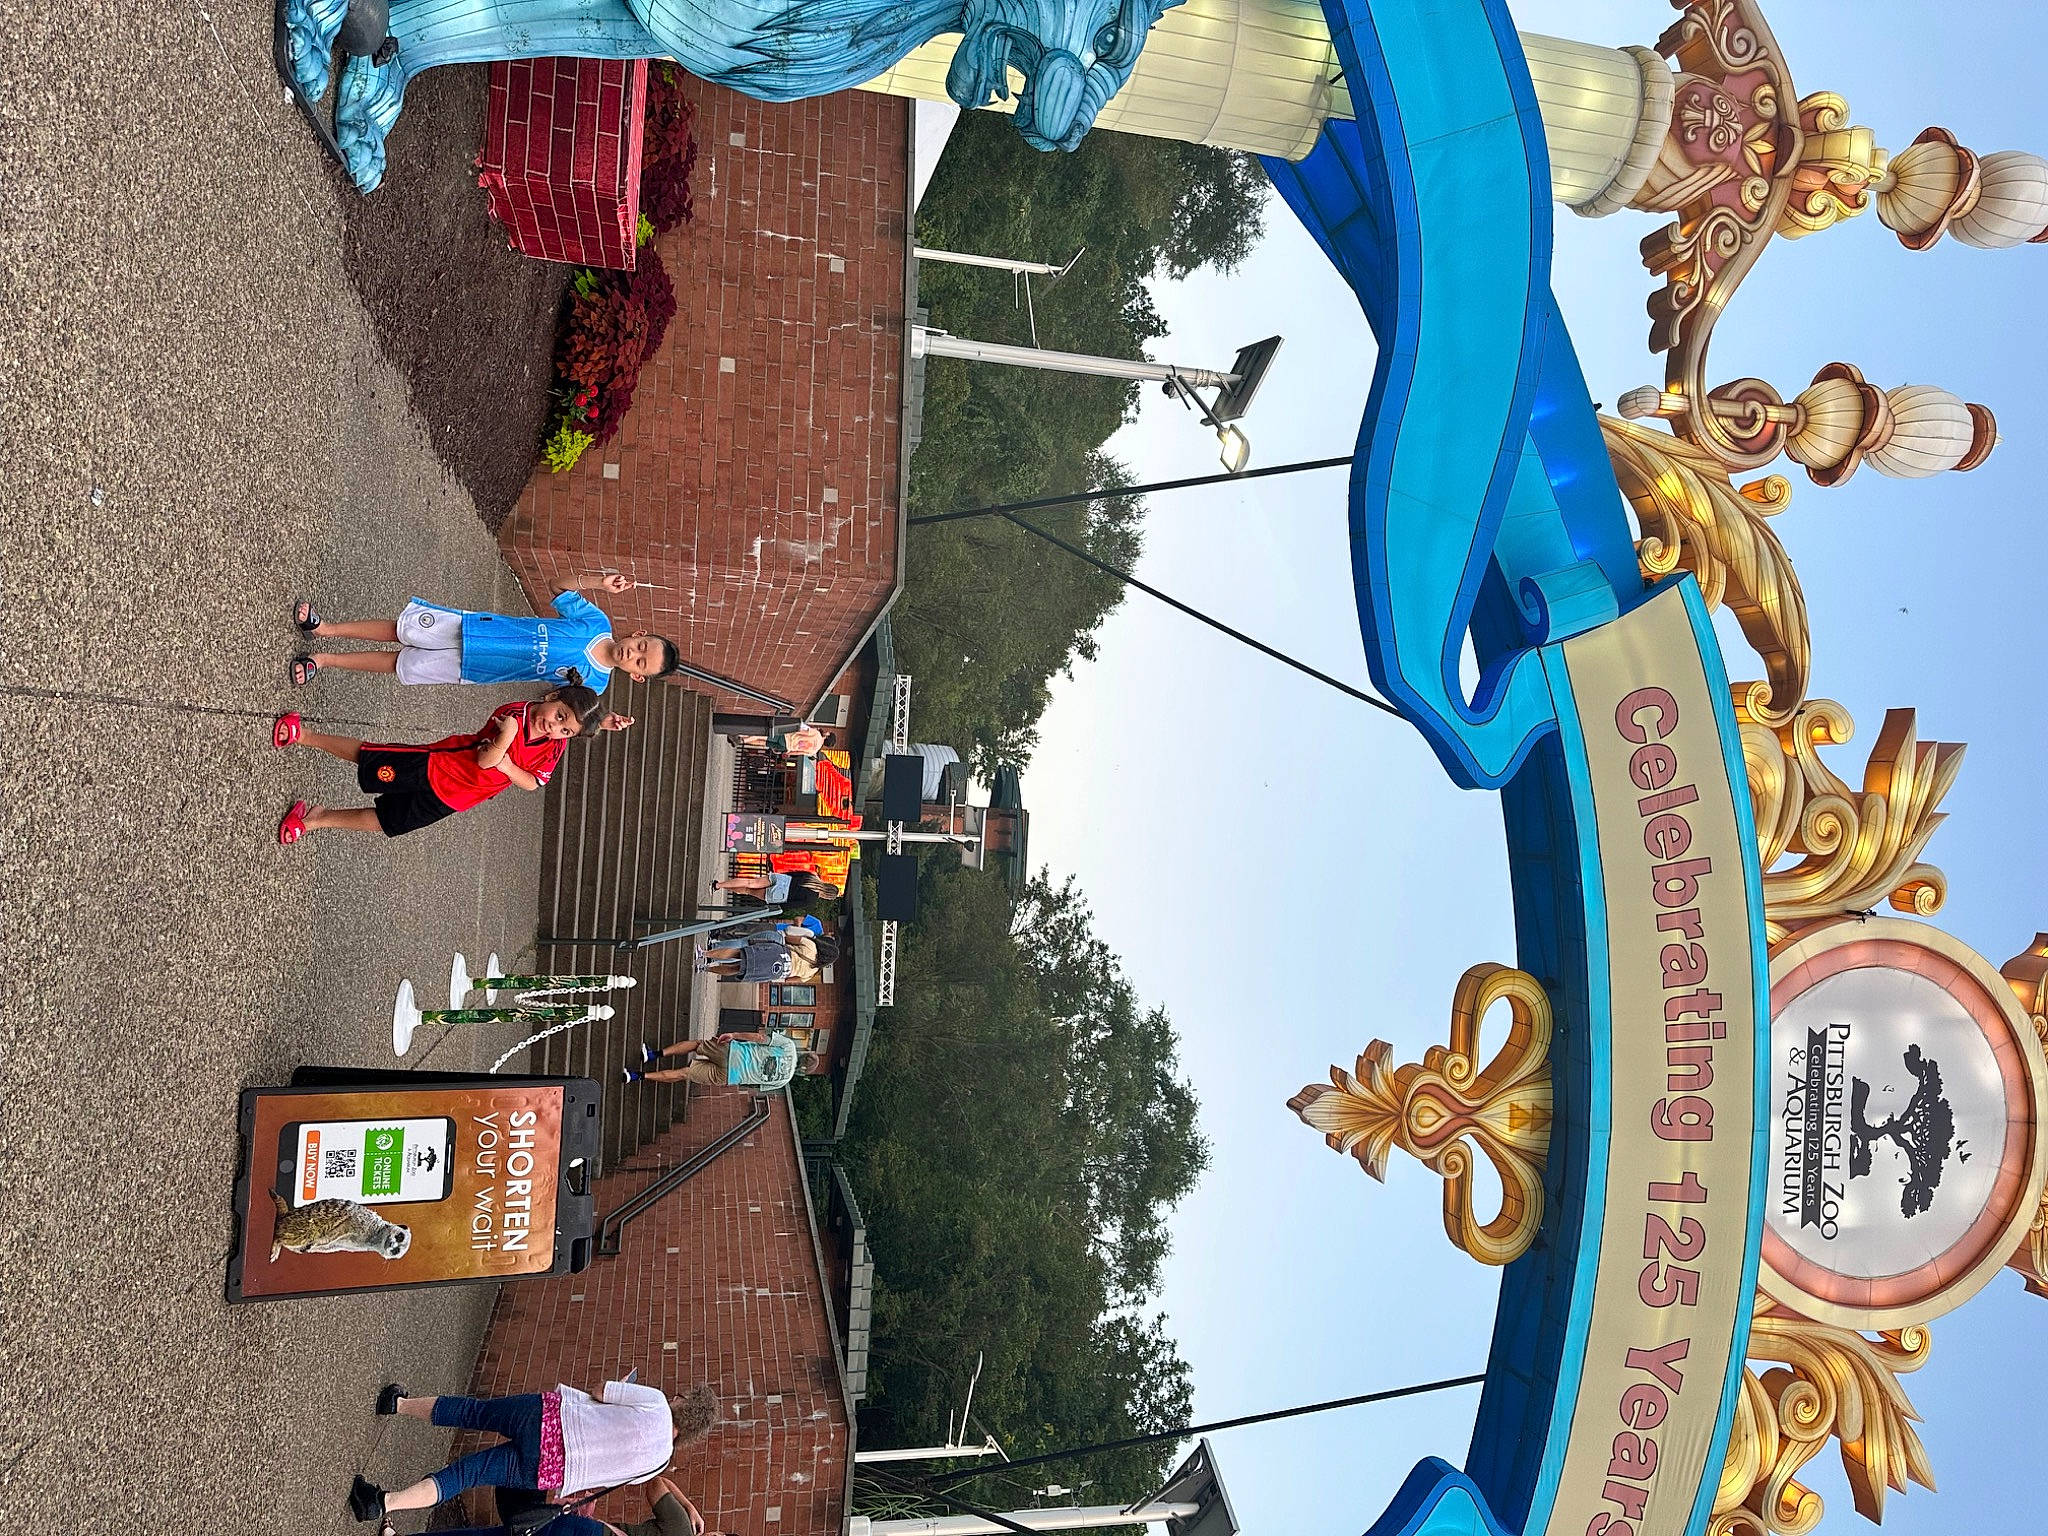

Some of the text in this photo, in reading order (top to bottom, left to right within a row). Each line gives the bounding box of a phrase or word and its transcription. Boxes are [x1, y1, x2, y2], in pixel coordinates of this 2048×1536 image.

[536, 624, 548, 674] ETIHAD
[305, 1143, 318, 1189] BUY NOW
[373, 1157, 383, 1190] TICKETS
[381, 1157, 392, 1190] ONLINE
[502, 1110, 536, 1251] SHORTEN
[1585, 686, 1726, 1536] Celebrating 125 Years
[1782, 1047, 1807, 1215] & AQUARIUM
[1806, 1044, 1822, 1206] Celebrating 125 Years
[1821, 1023, 1850, 1240] PITTSBURGH ZOO
[471, 1112, 499, 1251] your wait
